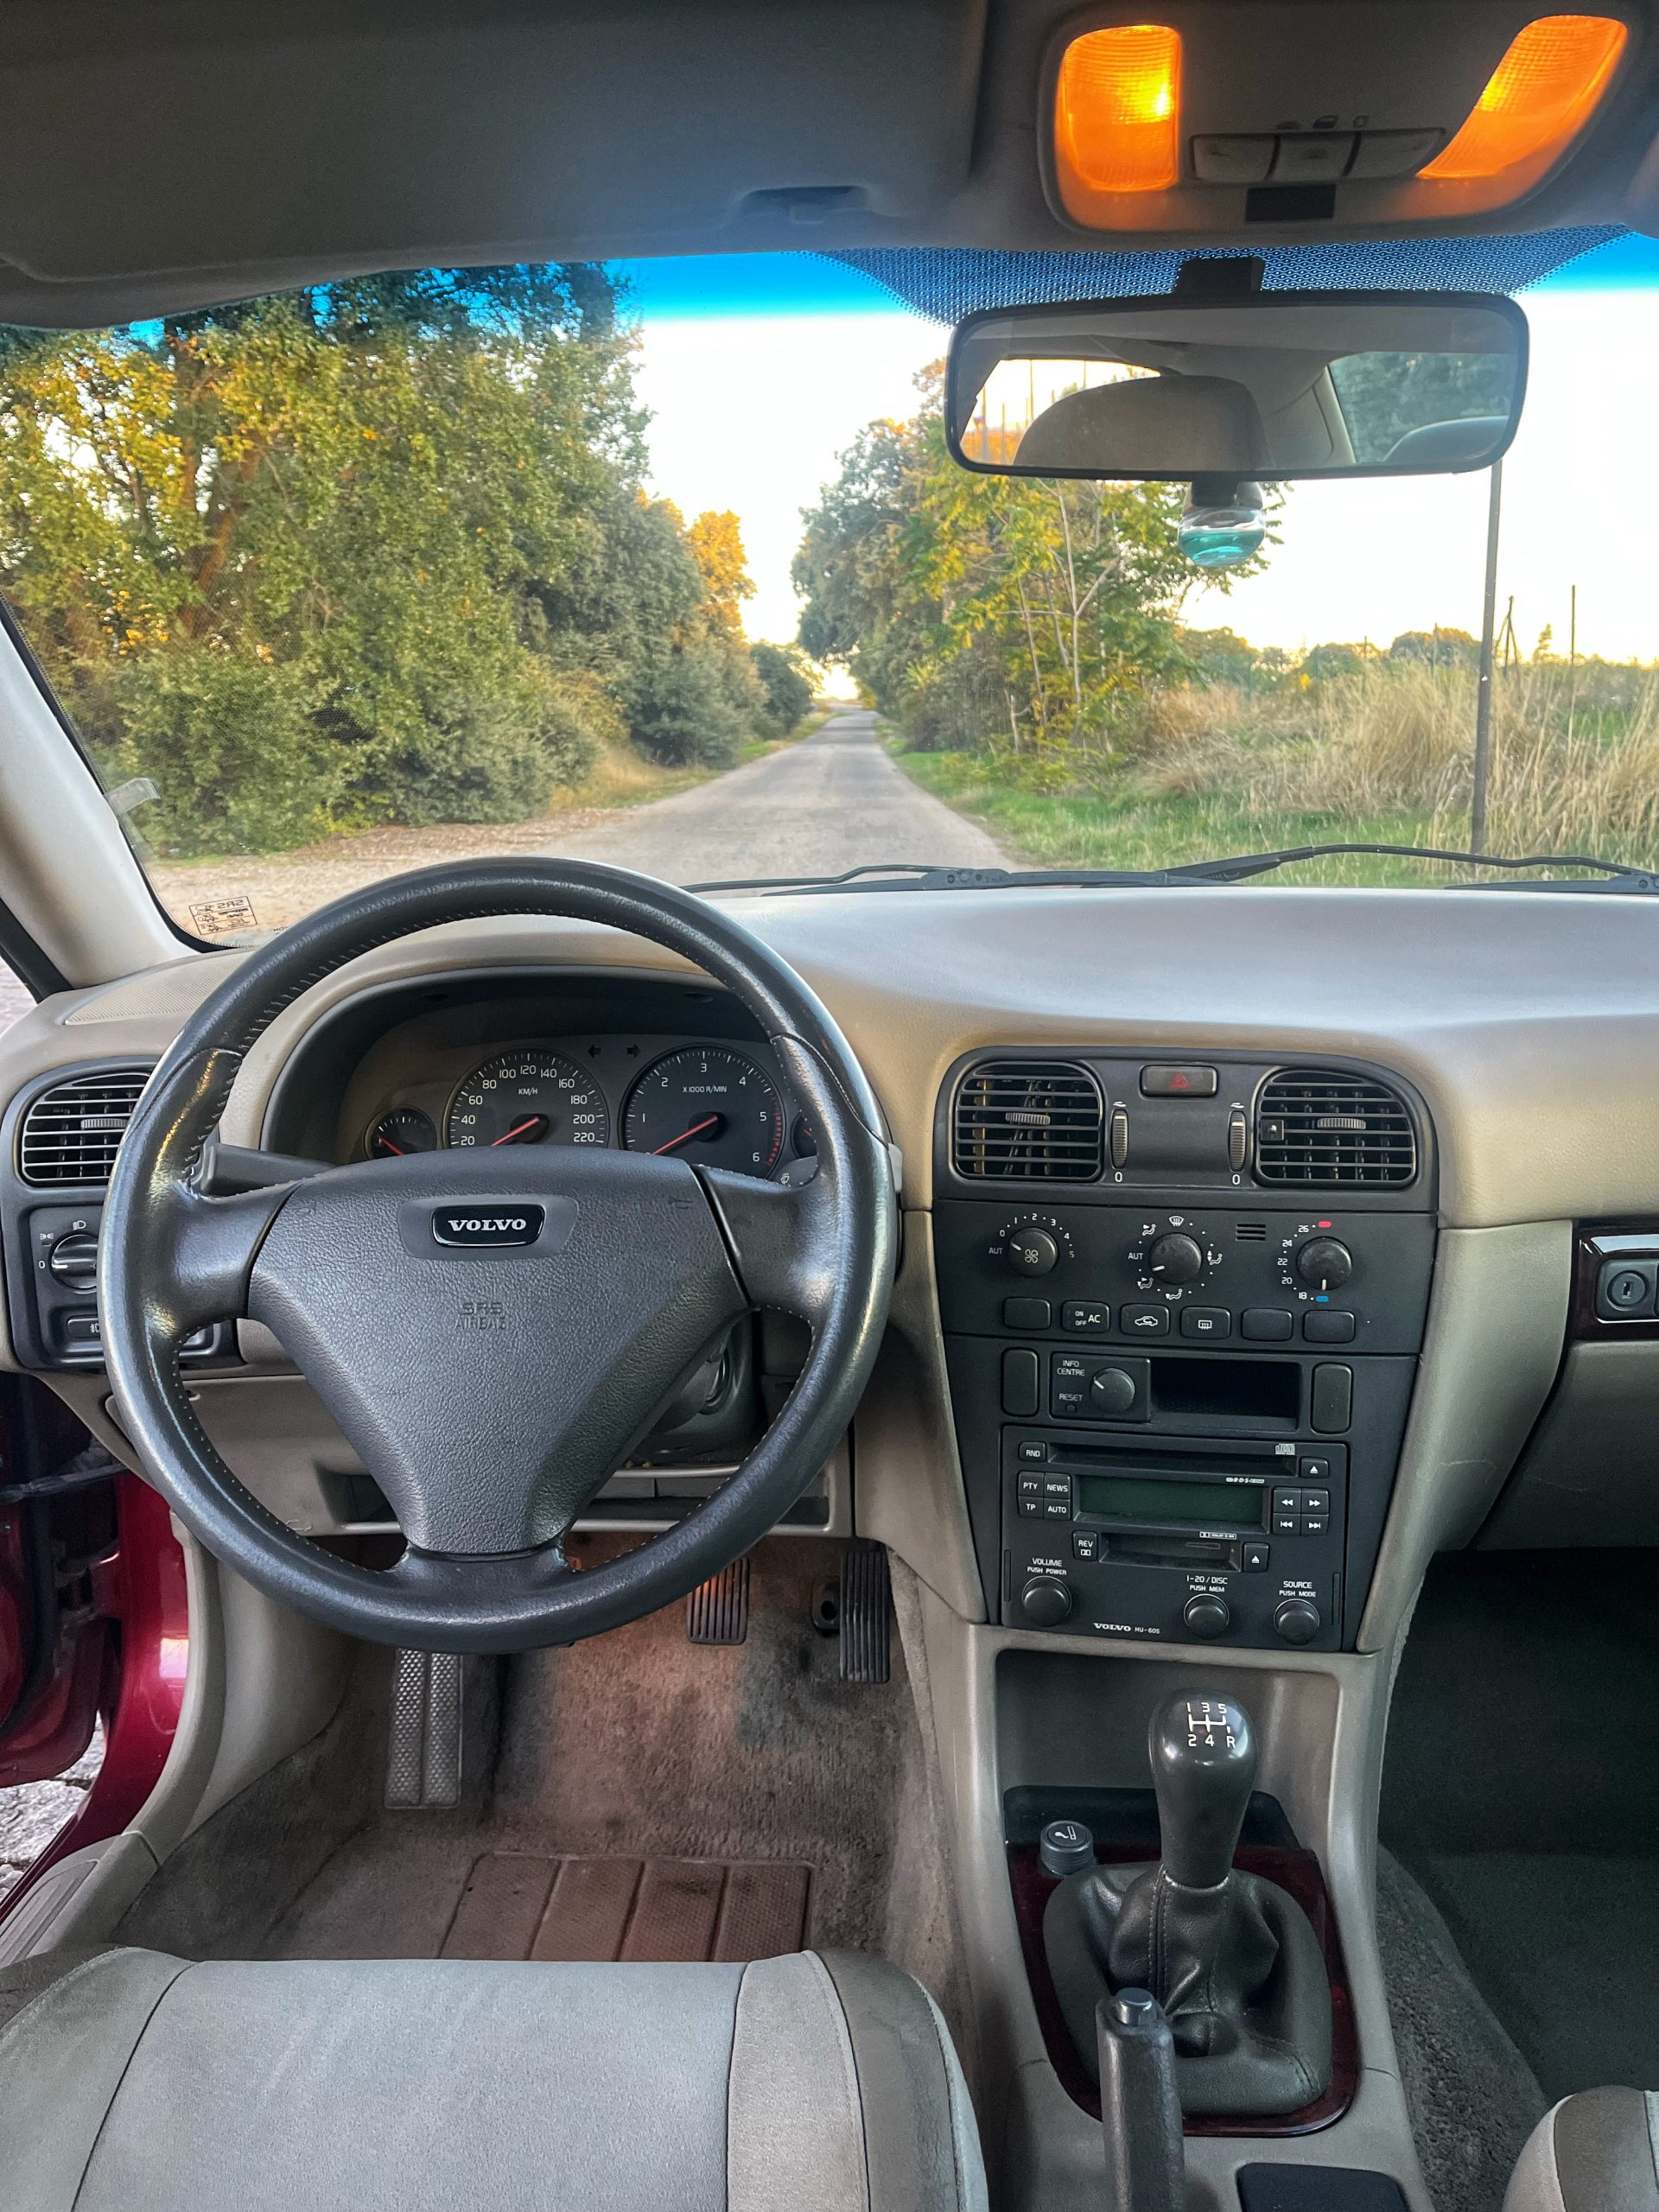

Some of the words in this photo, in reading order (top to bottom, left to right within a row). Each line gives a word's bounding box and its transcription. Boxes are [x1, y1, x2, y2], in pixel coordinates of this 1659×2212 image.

[520, 1065, 537, 1075] 120
[701, 1063, 707, 1072] 3
[499, 1069, 516, 1078] 100
[541, 1068, 557, 1078] 140
[482, 1079, 497, 1089] 80
[559, 1078, 575, 1088] 160
[661, 1077, 669, 1087] 2
[739, 1076, 747, 1086] 4
[518, 1087, 537, 1096] KM/H
[706, 1085, 728, 1094] R/MIN
[468, 1095, 483, 1105] 60
[571, 1095, 588, 1104] 180
[461, 1115, 475, 1125] 40
[573, 1114, 594, 1124] 200
[760, 1112, 766, 1122] 5
[461, 1136, 475, 1146] 20
[573, 1132, 594, 1141] 220
[753, 1152, 760, 1162] 6
[1115, 1172, 1122, 1182] 0
[1232, 1174, 1241, 1185] 0
[448, 1219, 526, 1231] VOLVO
[1088, 1314, 1101, 1323] AC
[1057, 1368, 1085, 1376] CENTRE
[1058, 1393, 1084, 1402] RESET
[1026, 1449, 1040, 1458] RND
[1046, 1484, 1068, 1492] NEWS
[1047, 1505, 1067, 1514] AUTO
[1033, 1558, 1062, 1567] VOLUME
[1211, 1576, 1228, 1585] DISC
[1283, 1580, 1313, 1589] SOURCE
[1093, 1622, 1131, 1631] VOLVO
[1186, 1701, 1192, 1712] 1
[1201, 1701, 1210, 1713] 3
[1217, 1703, 1227, 1713] 5
[1187, 1733, 1197, 1746] 2
[1205, 1734, 1214, 1746] 4
[1226, 1735, 1236, 1749] R
